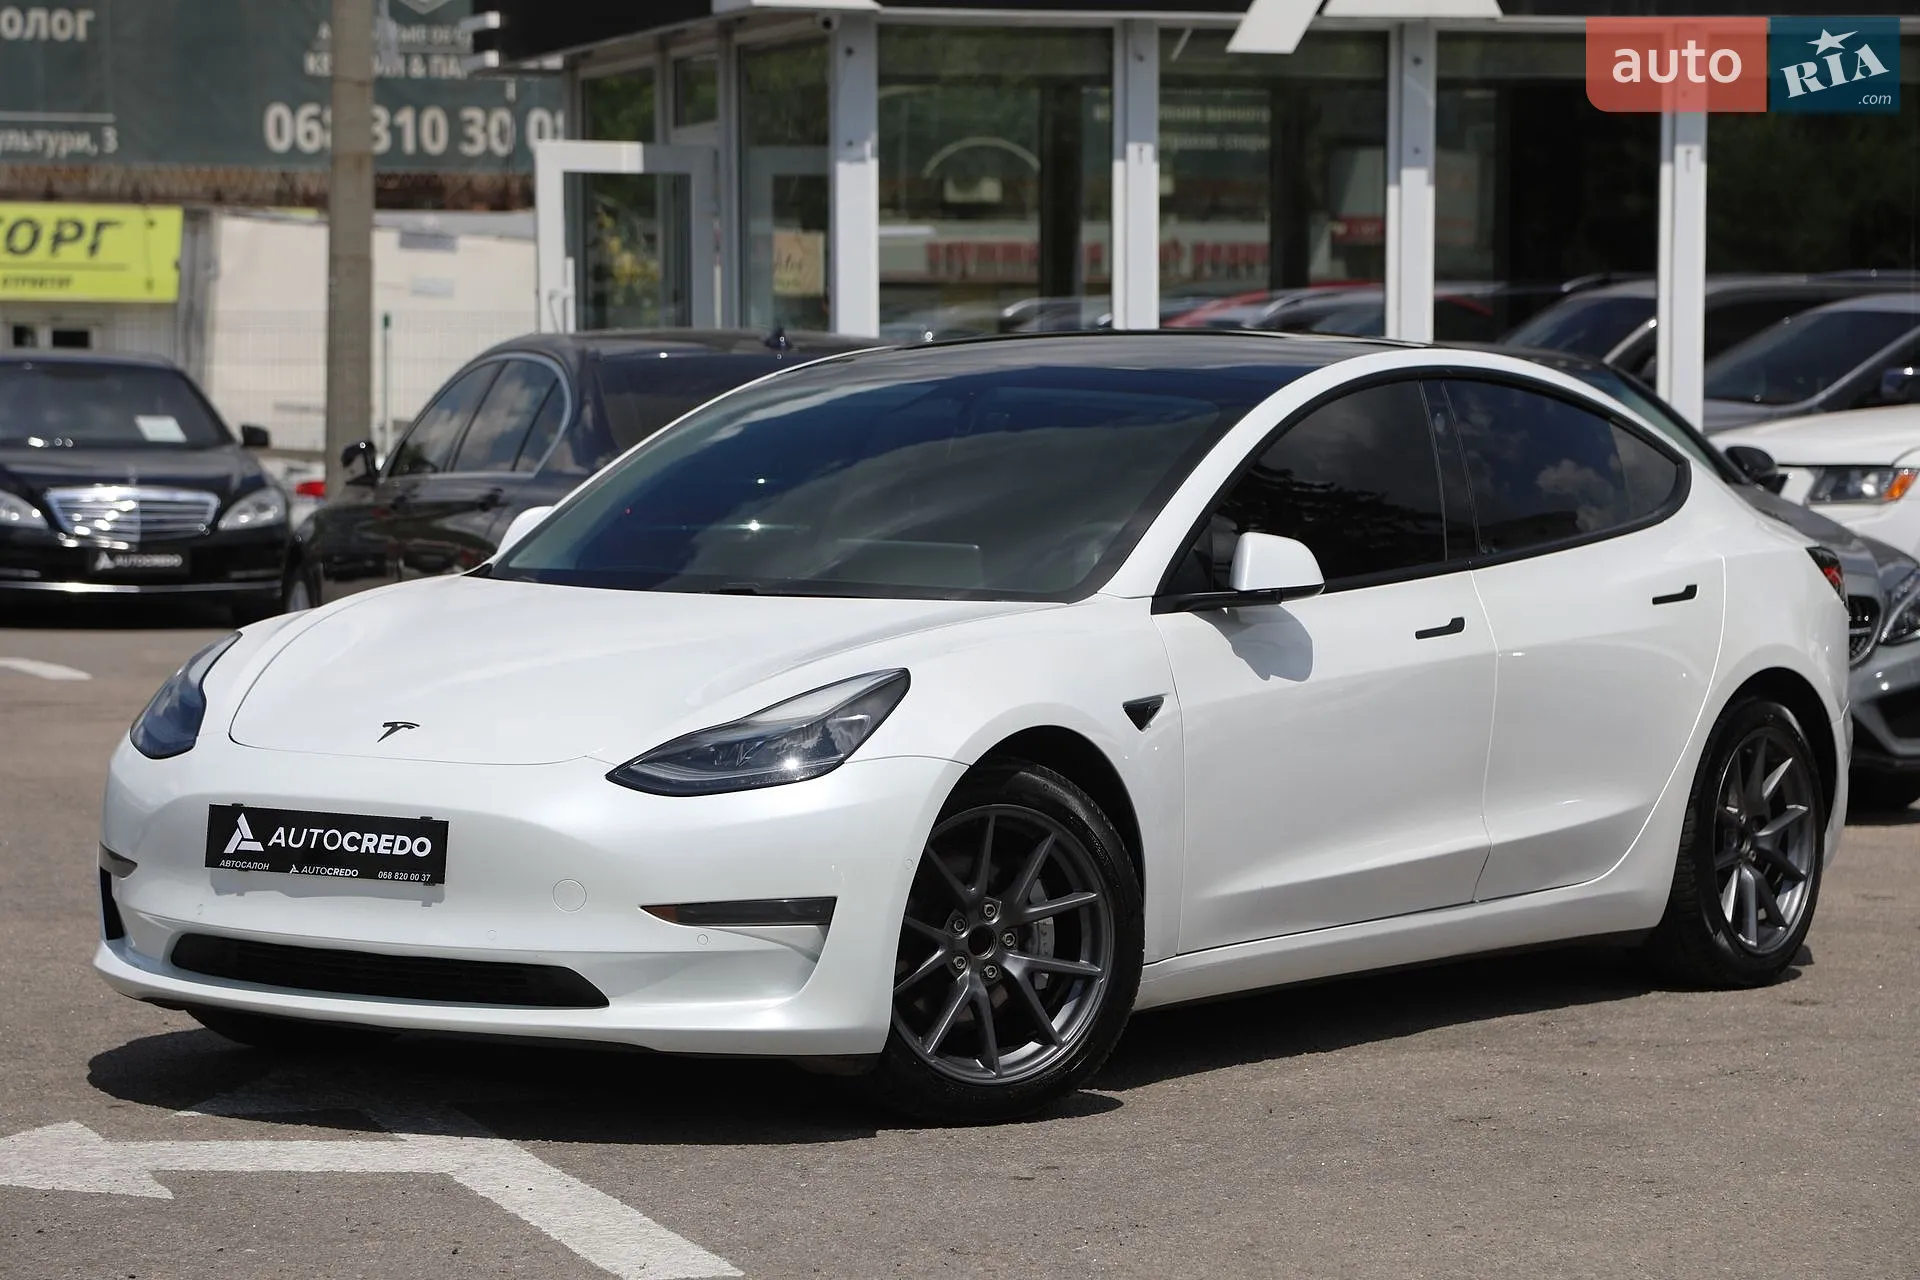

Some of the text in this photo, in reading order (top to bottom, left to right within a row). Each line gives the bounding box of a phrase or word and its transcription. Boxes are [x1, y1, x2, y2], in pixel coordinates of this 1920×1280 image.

[459, 107, 516, 157] 30
[0, 217, 125, 258] ОРГ
[268, 827, 432, 857] AUTOCREDO
[219, 859, 270, 871] АВТОСАЛОН
[301, 865, 359, 877] AUTOCREDO
